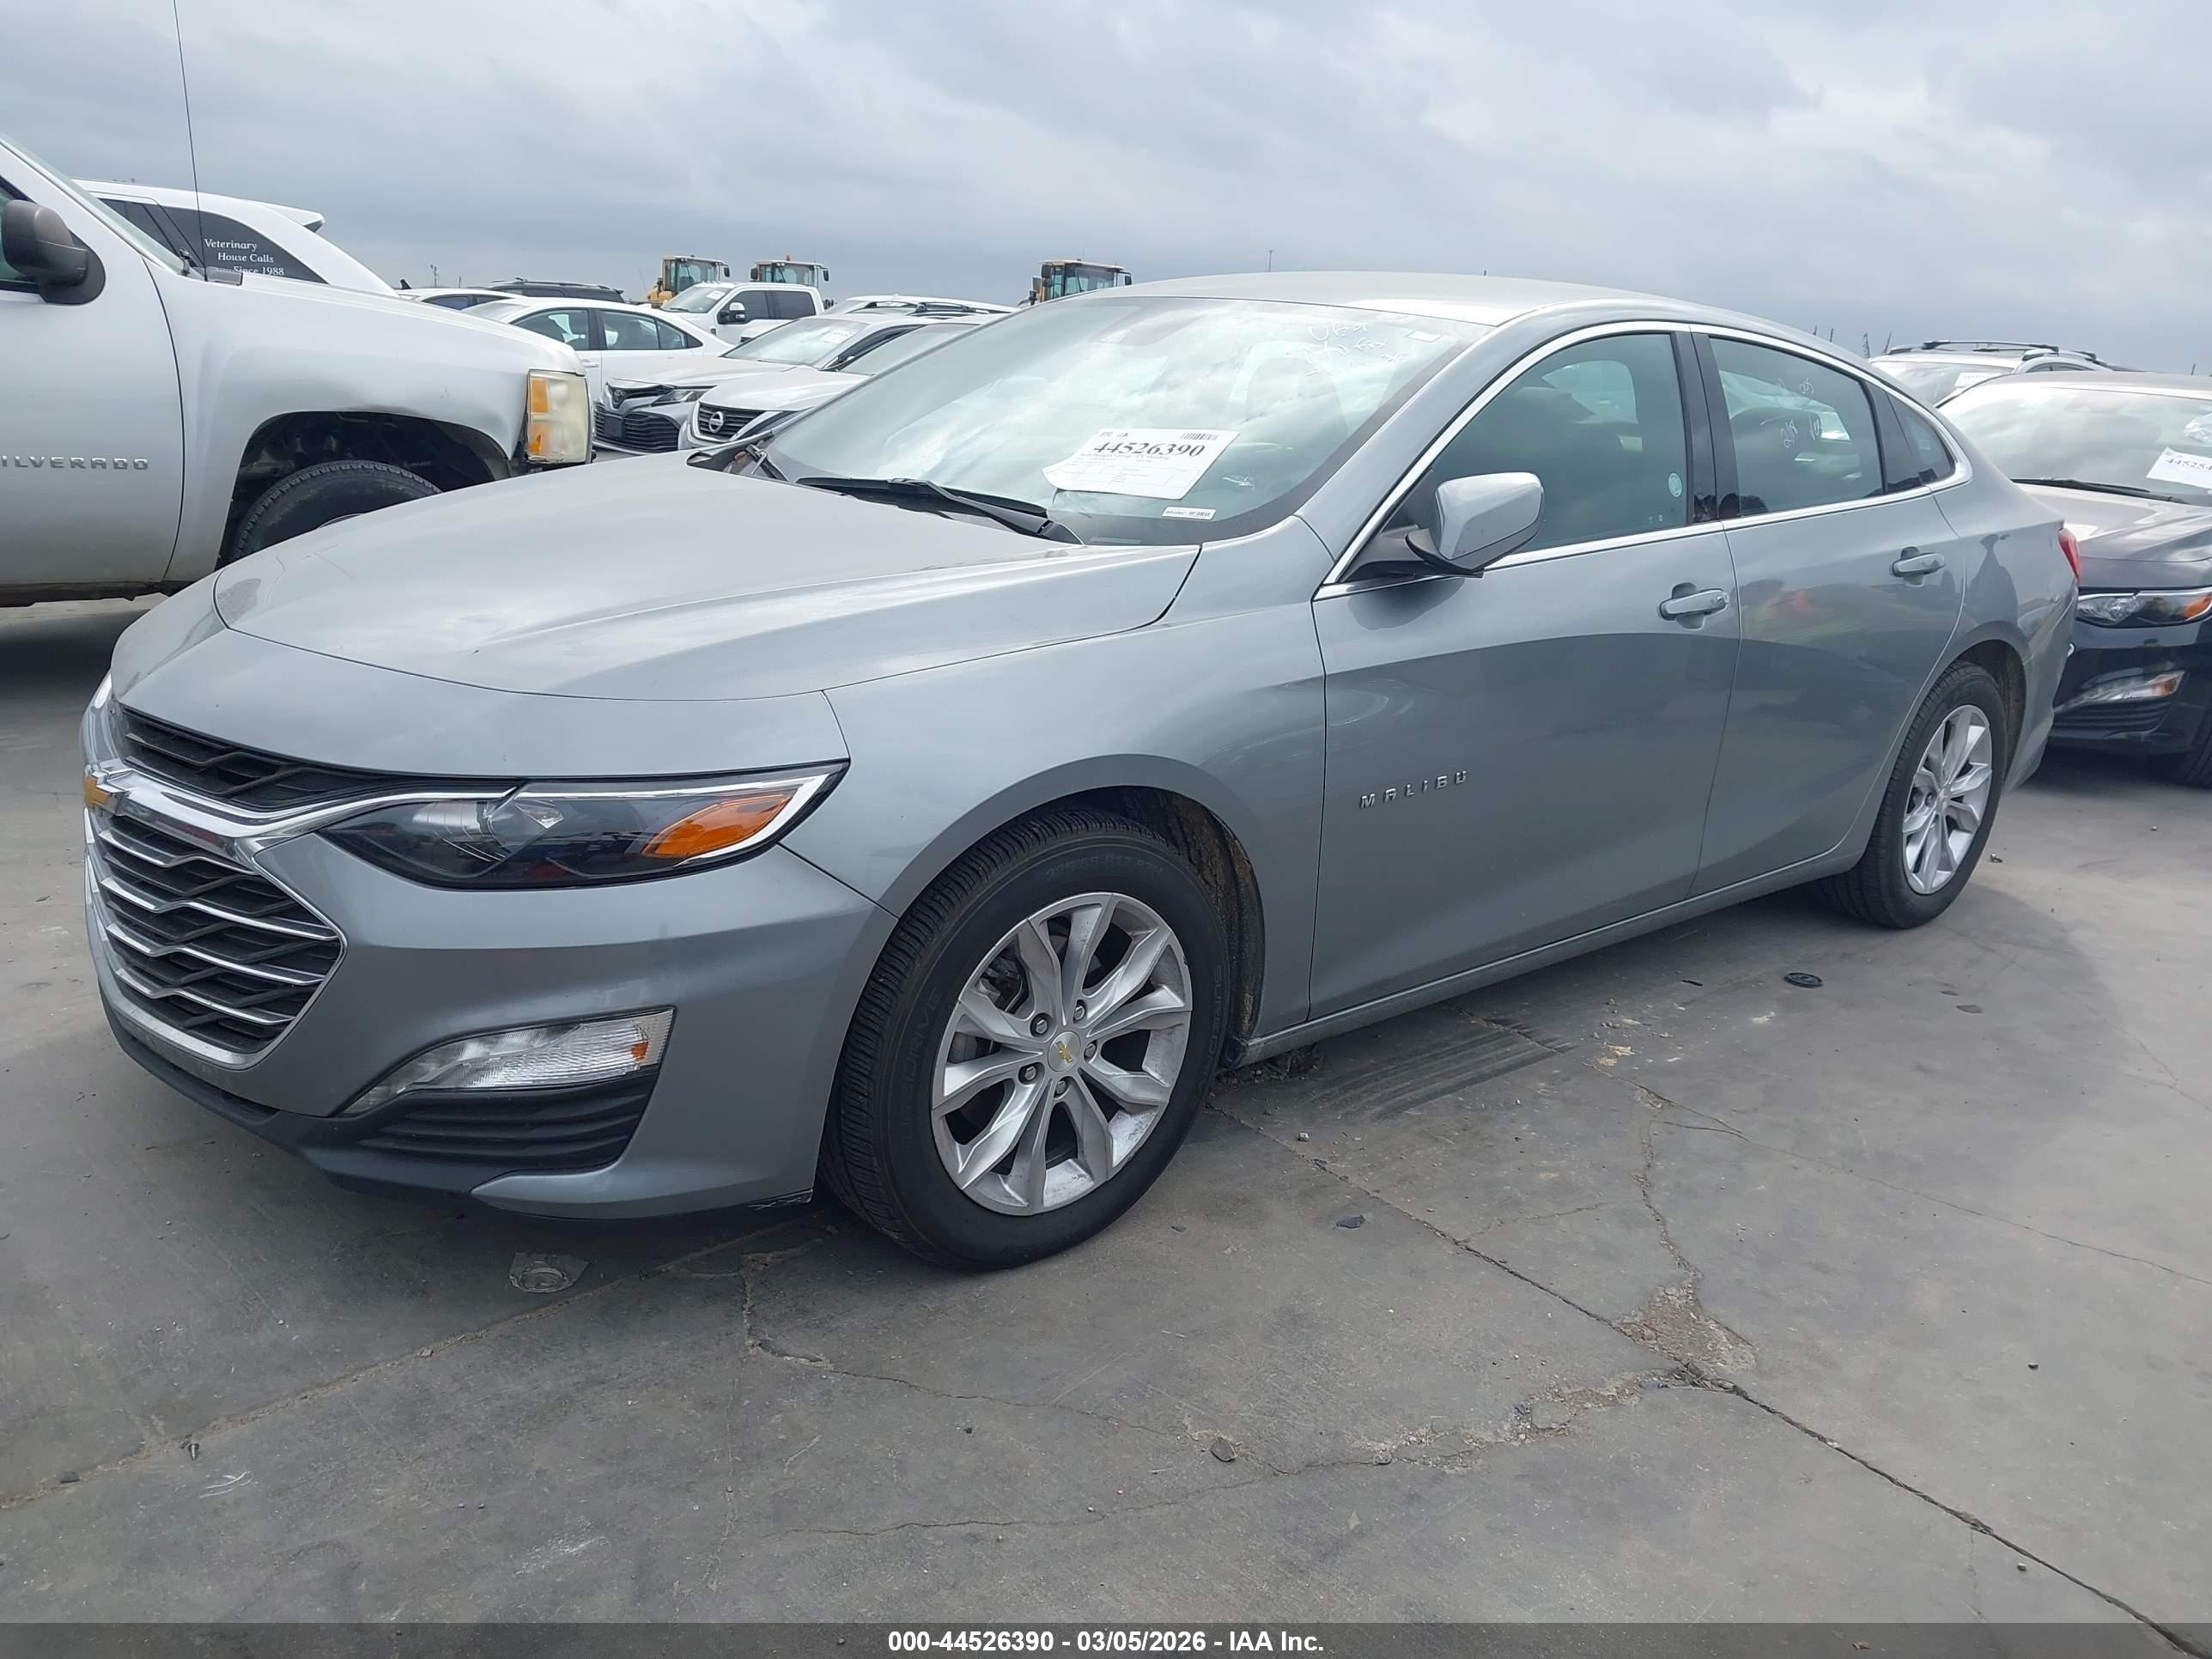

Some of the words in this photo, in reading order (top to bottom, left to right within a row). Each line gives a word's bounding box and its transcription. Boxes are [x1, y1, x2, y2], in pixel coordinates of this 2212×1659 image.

[204, 239, 257, 252] Veterinary
[218, 252, 247, 262] House
[249, 253, 275, 263] Calls
[262, 266, 284, 276] 1988
[1093, 441, 1206, 457] 44526390
[1360, 770, 1468, 809] MALIBU
